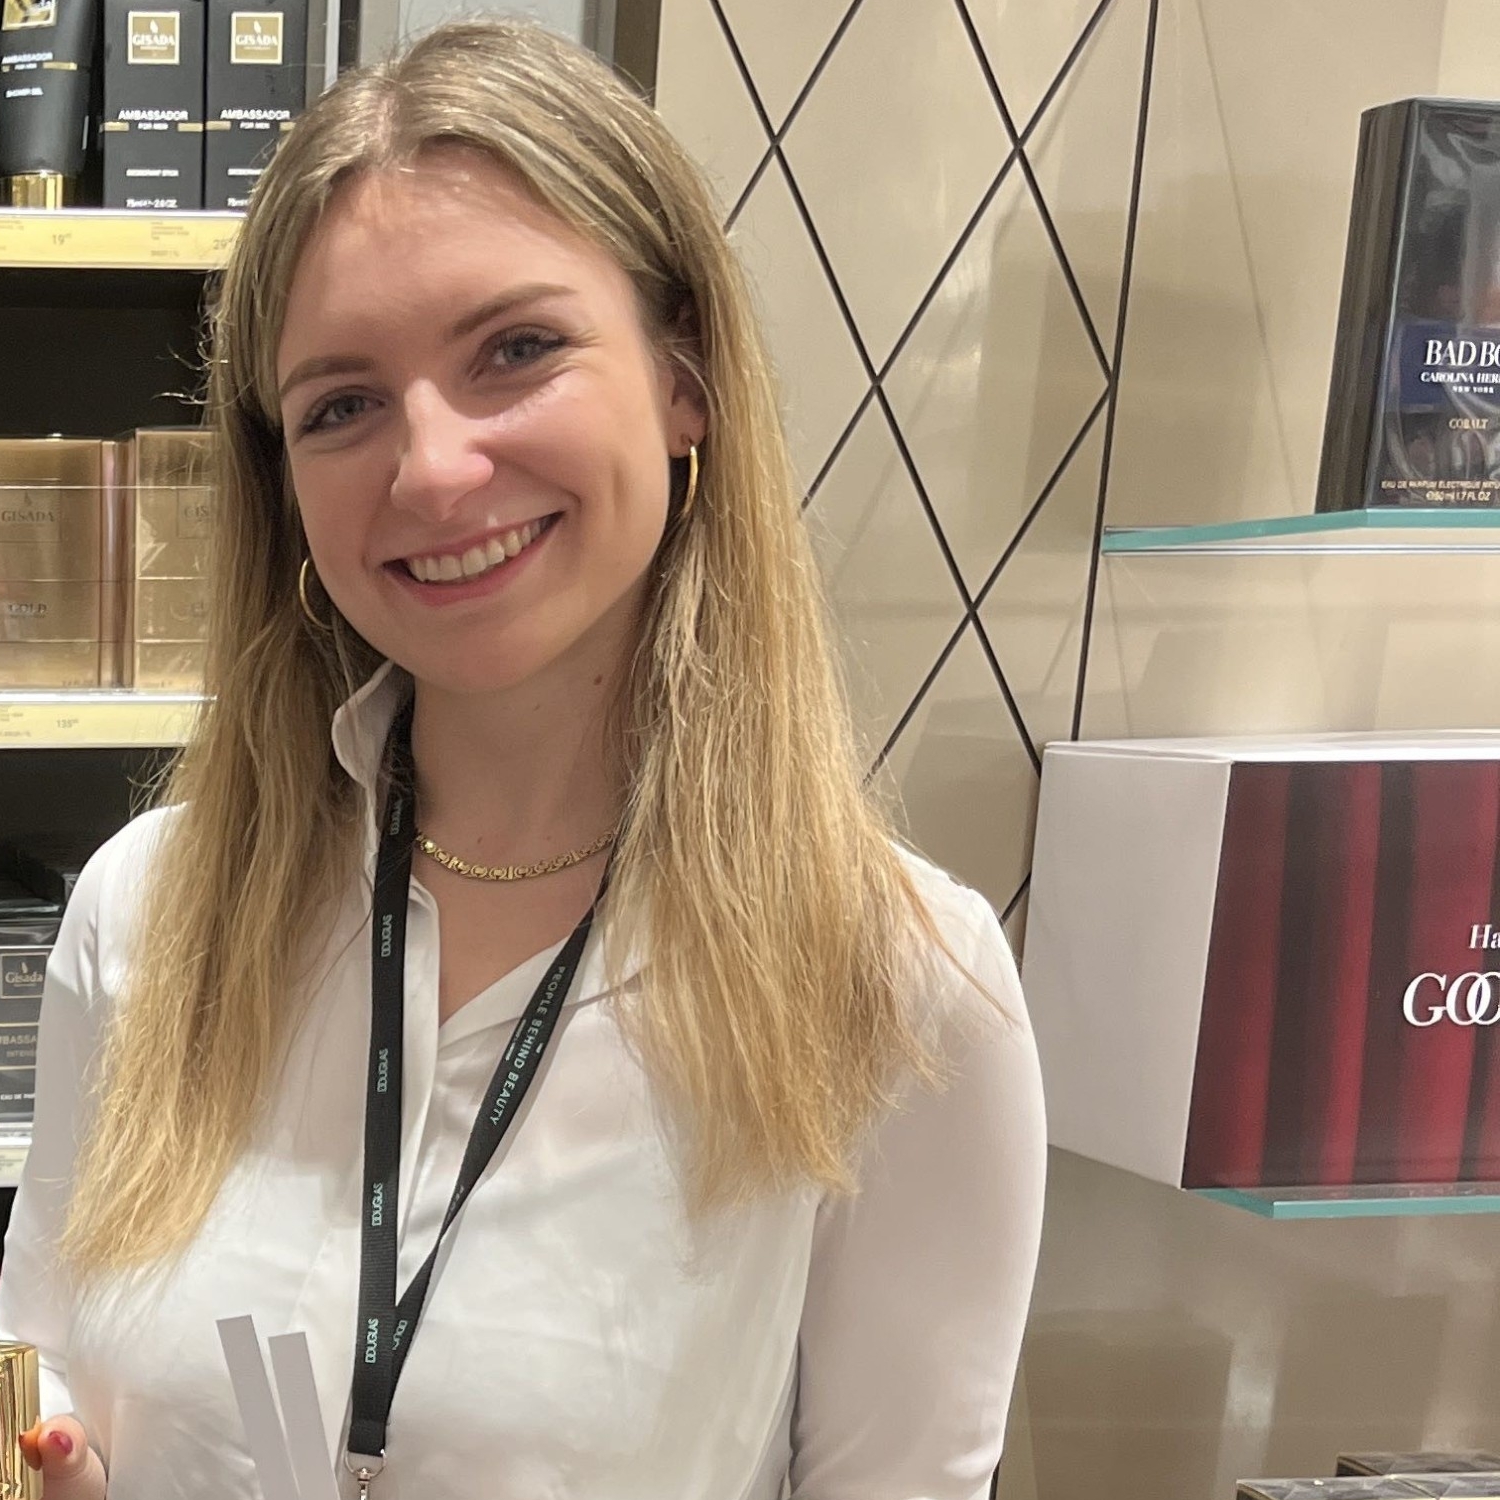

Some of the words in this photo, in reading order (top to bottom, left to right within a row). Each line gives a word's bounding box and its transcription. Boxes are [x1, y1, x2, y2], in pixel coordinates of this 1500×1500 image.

[132, 34, 175, 46] GISADA
[235, 34, 278, 46] GISADA
[118, 109, 189, 121] AMBASSADOR
[220, 109, 291, 121] AMBASSADOR
[1424, 339, 1477, 367] BAD
[1421, 371, 1474, 383] CAROLINA
[1449, 418, 1488, 430] COBALT
[1, 510, 55, 523] GISADA
[8, 603, 47, 614] GOLD
[381, 913, 393, 958] DOUGLAS
[5, 971, 44, 986] Gisada
[535, 965, 566, 1016] PEOPLE
[513, 1018, 544, 1070] BEHIND
[376, 1048, 390, 1093] DOUGLAS
[489, 1068, 520, 1126] BEAUTY
[371, 1183, 383, 1227] DOUGLAS
[364, 1317, 379, 1364] DOUGLAS
